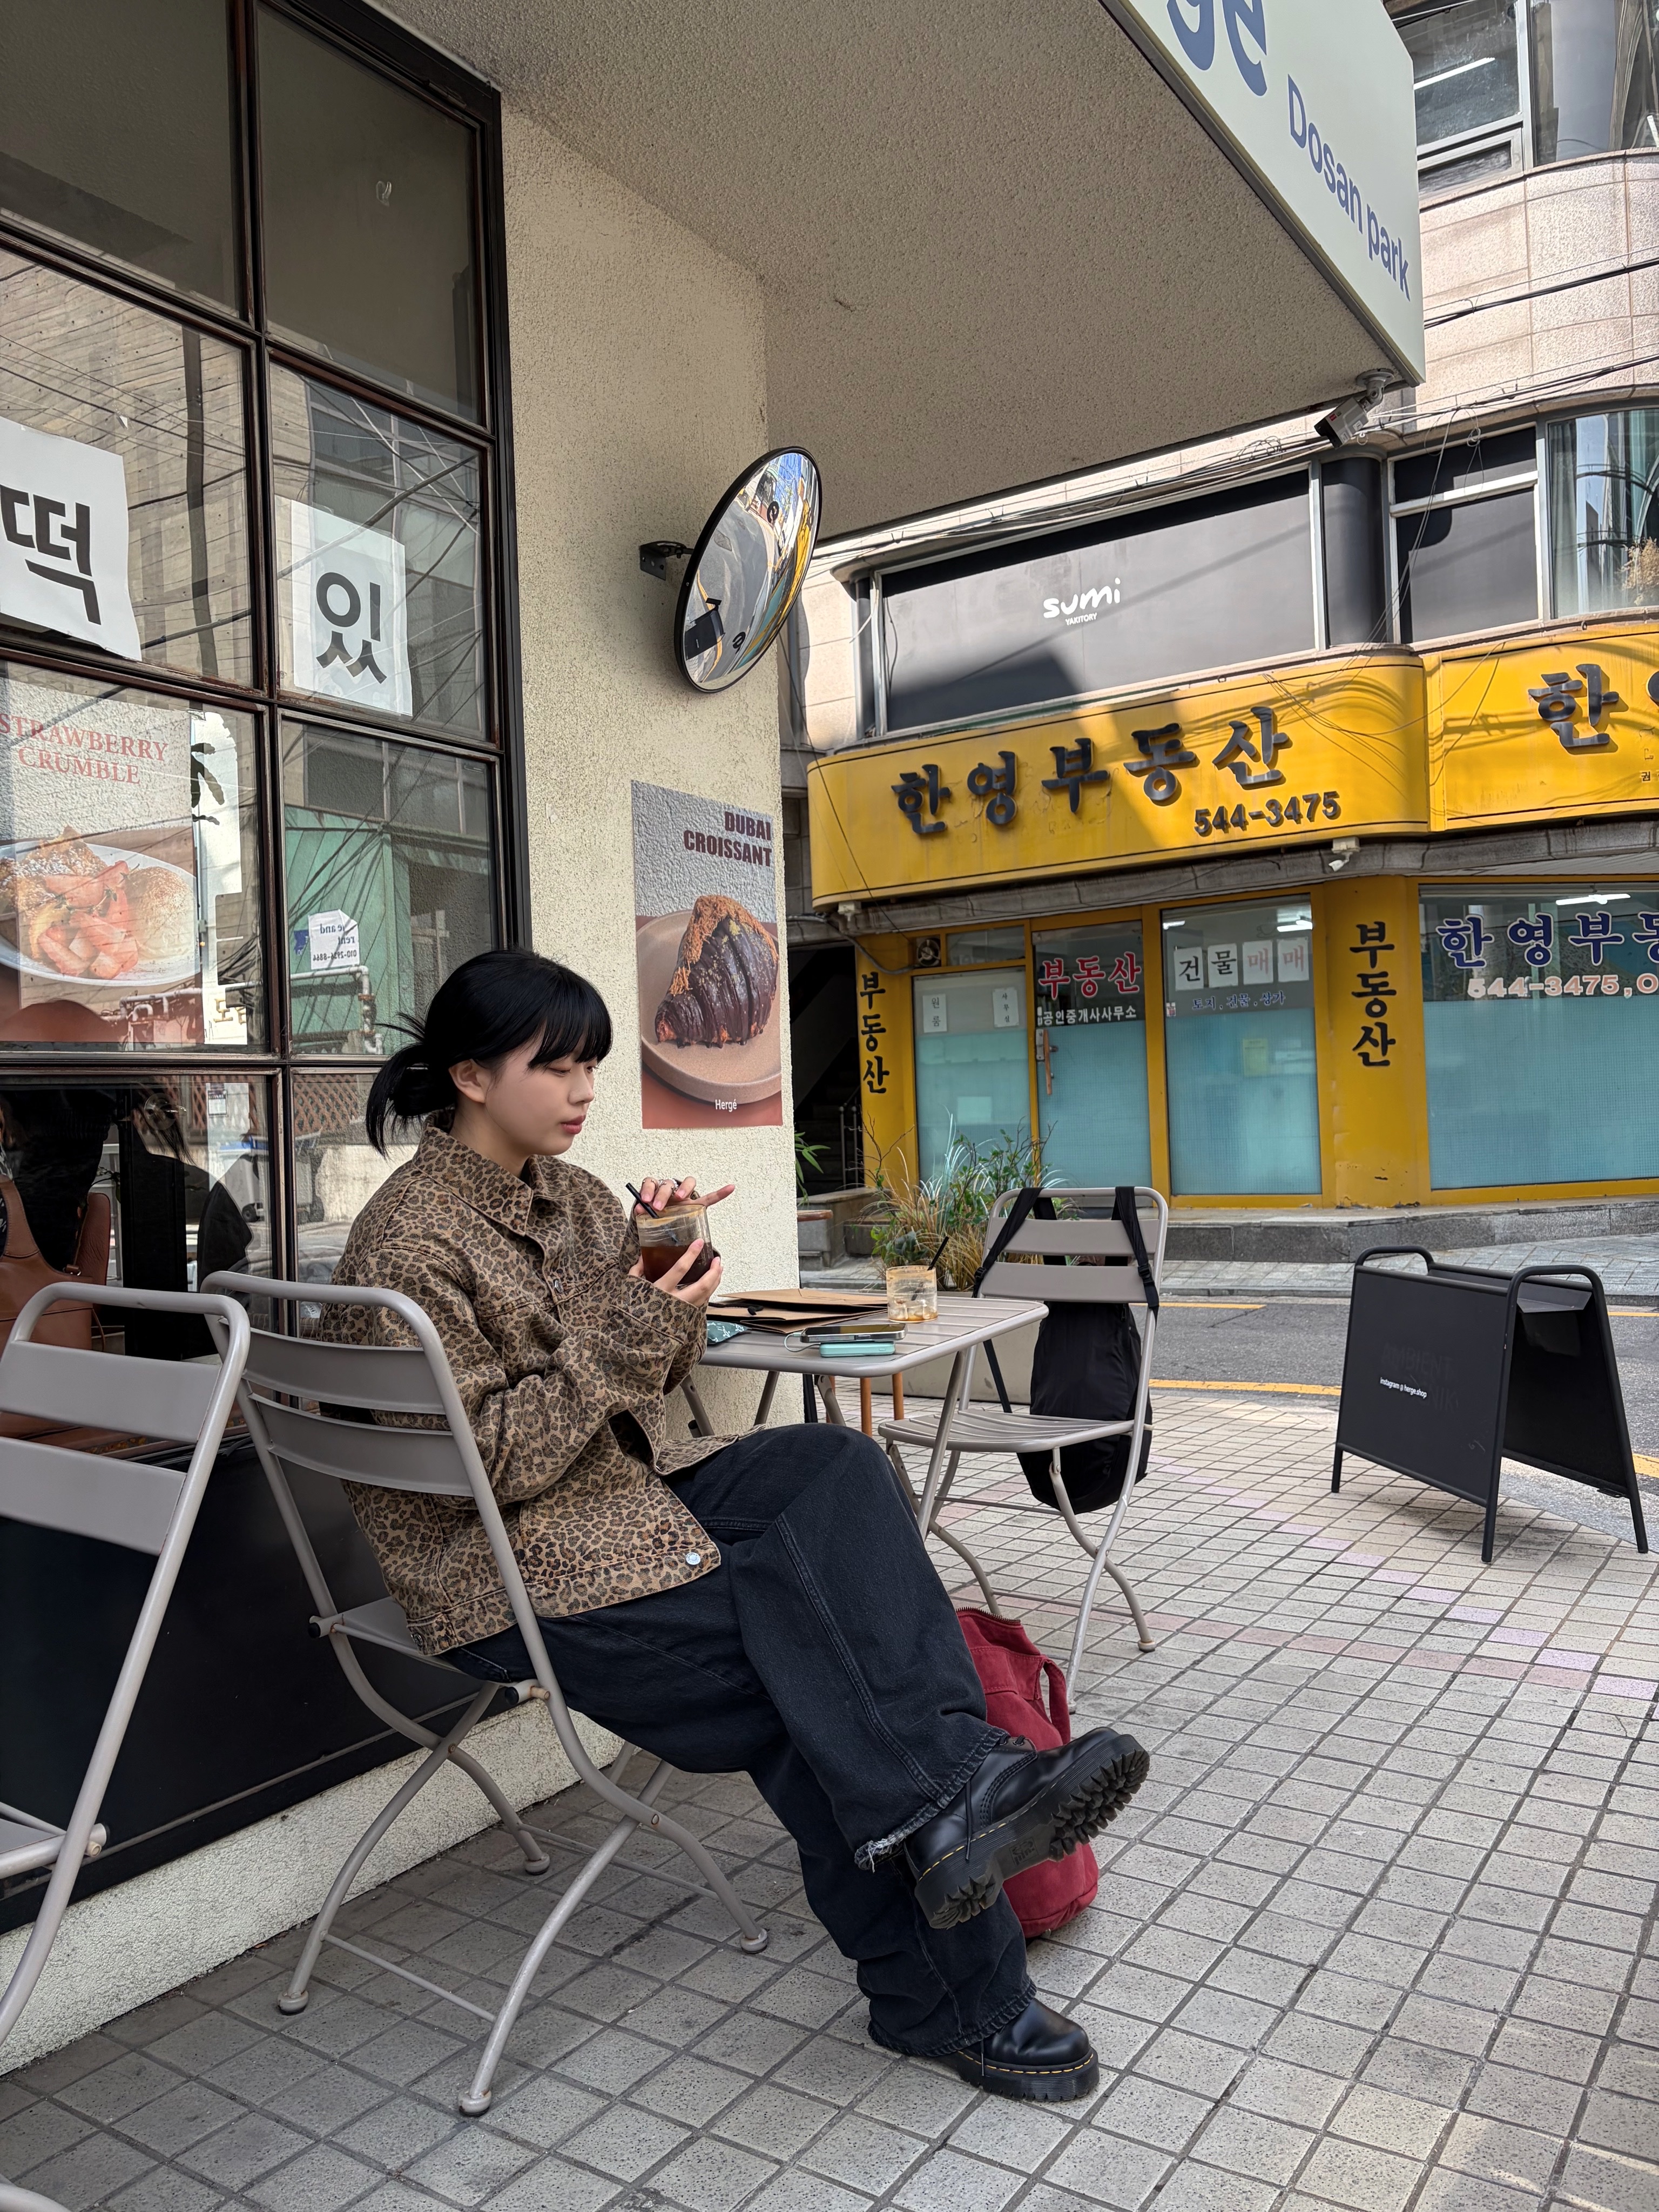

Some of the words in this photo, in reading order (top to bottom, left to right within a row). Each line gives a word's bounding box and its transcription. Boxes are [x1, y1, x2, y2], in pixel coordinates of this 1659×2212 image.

[1289, 75, 1363, 232] Dosan
[1367, 204, 1411, 301] park
[1043, 577, 1121, 618] sumi
[316, 571, 387, 684] 잇
[1065, 612, 1097, 625] YAKITORY
[0, 713, 168, 761] STRAWBERRY
[18, 746, 140, 784] CRUMBLE
[891, 706, 1293, 835] 한영부동산
[724, 811, 772, 841] DUBAI
[1195, 791, 1340, 837] 544-3475
[683, 830, 772, 867] CROISSANT
[1038, 951, 1142, 1000] 부동산
[1350, 921, 1397, 1067] 부동산
[932, 997, 941, 1027] 원룸
[1043, 1006, 1136, 1026] 공인중개사사무소
[1260, 990, 1286, 1006] 상가
[860, 972, 890, 1094] 부동산
[715, 1099, 737, 1112] Hergé
